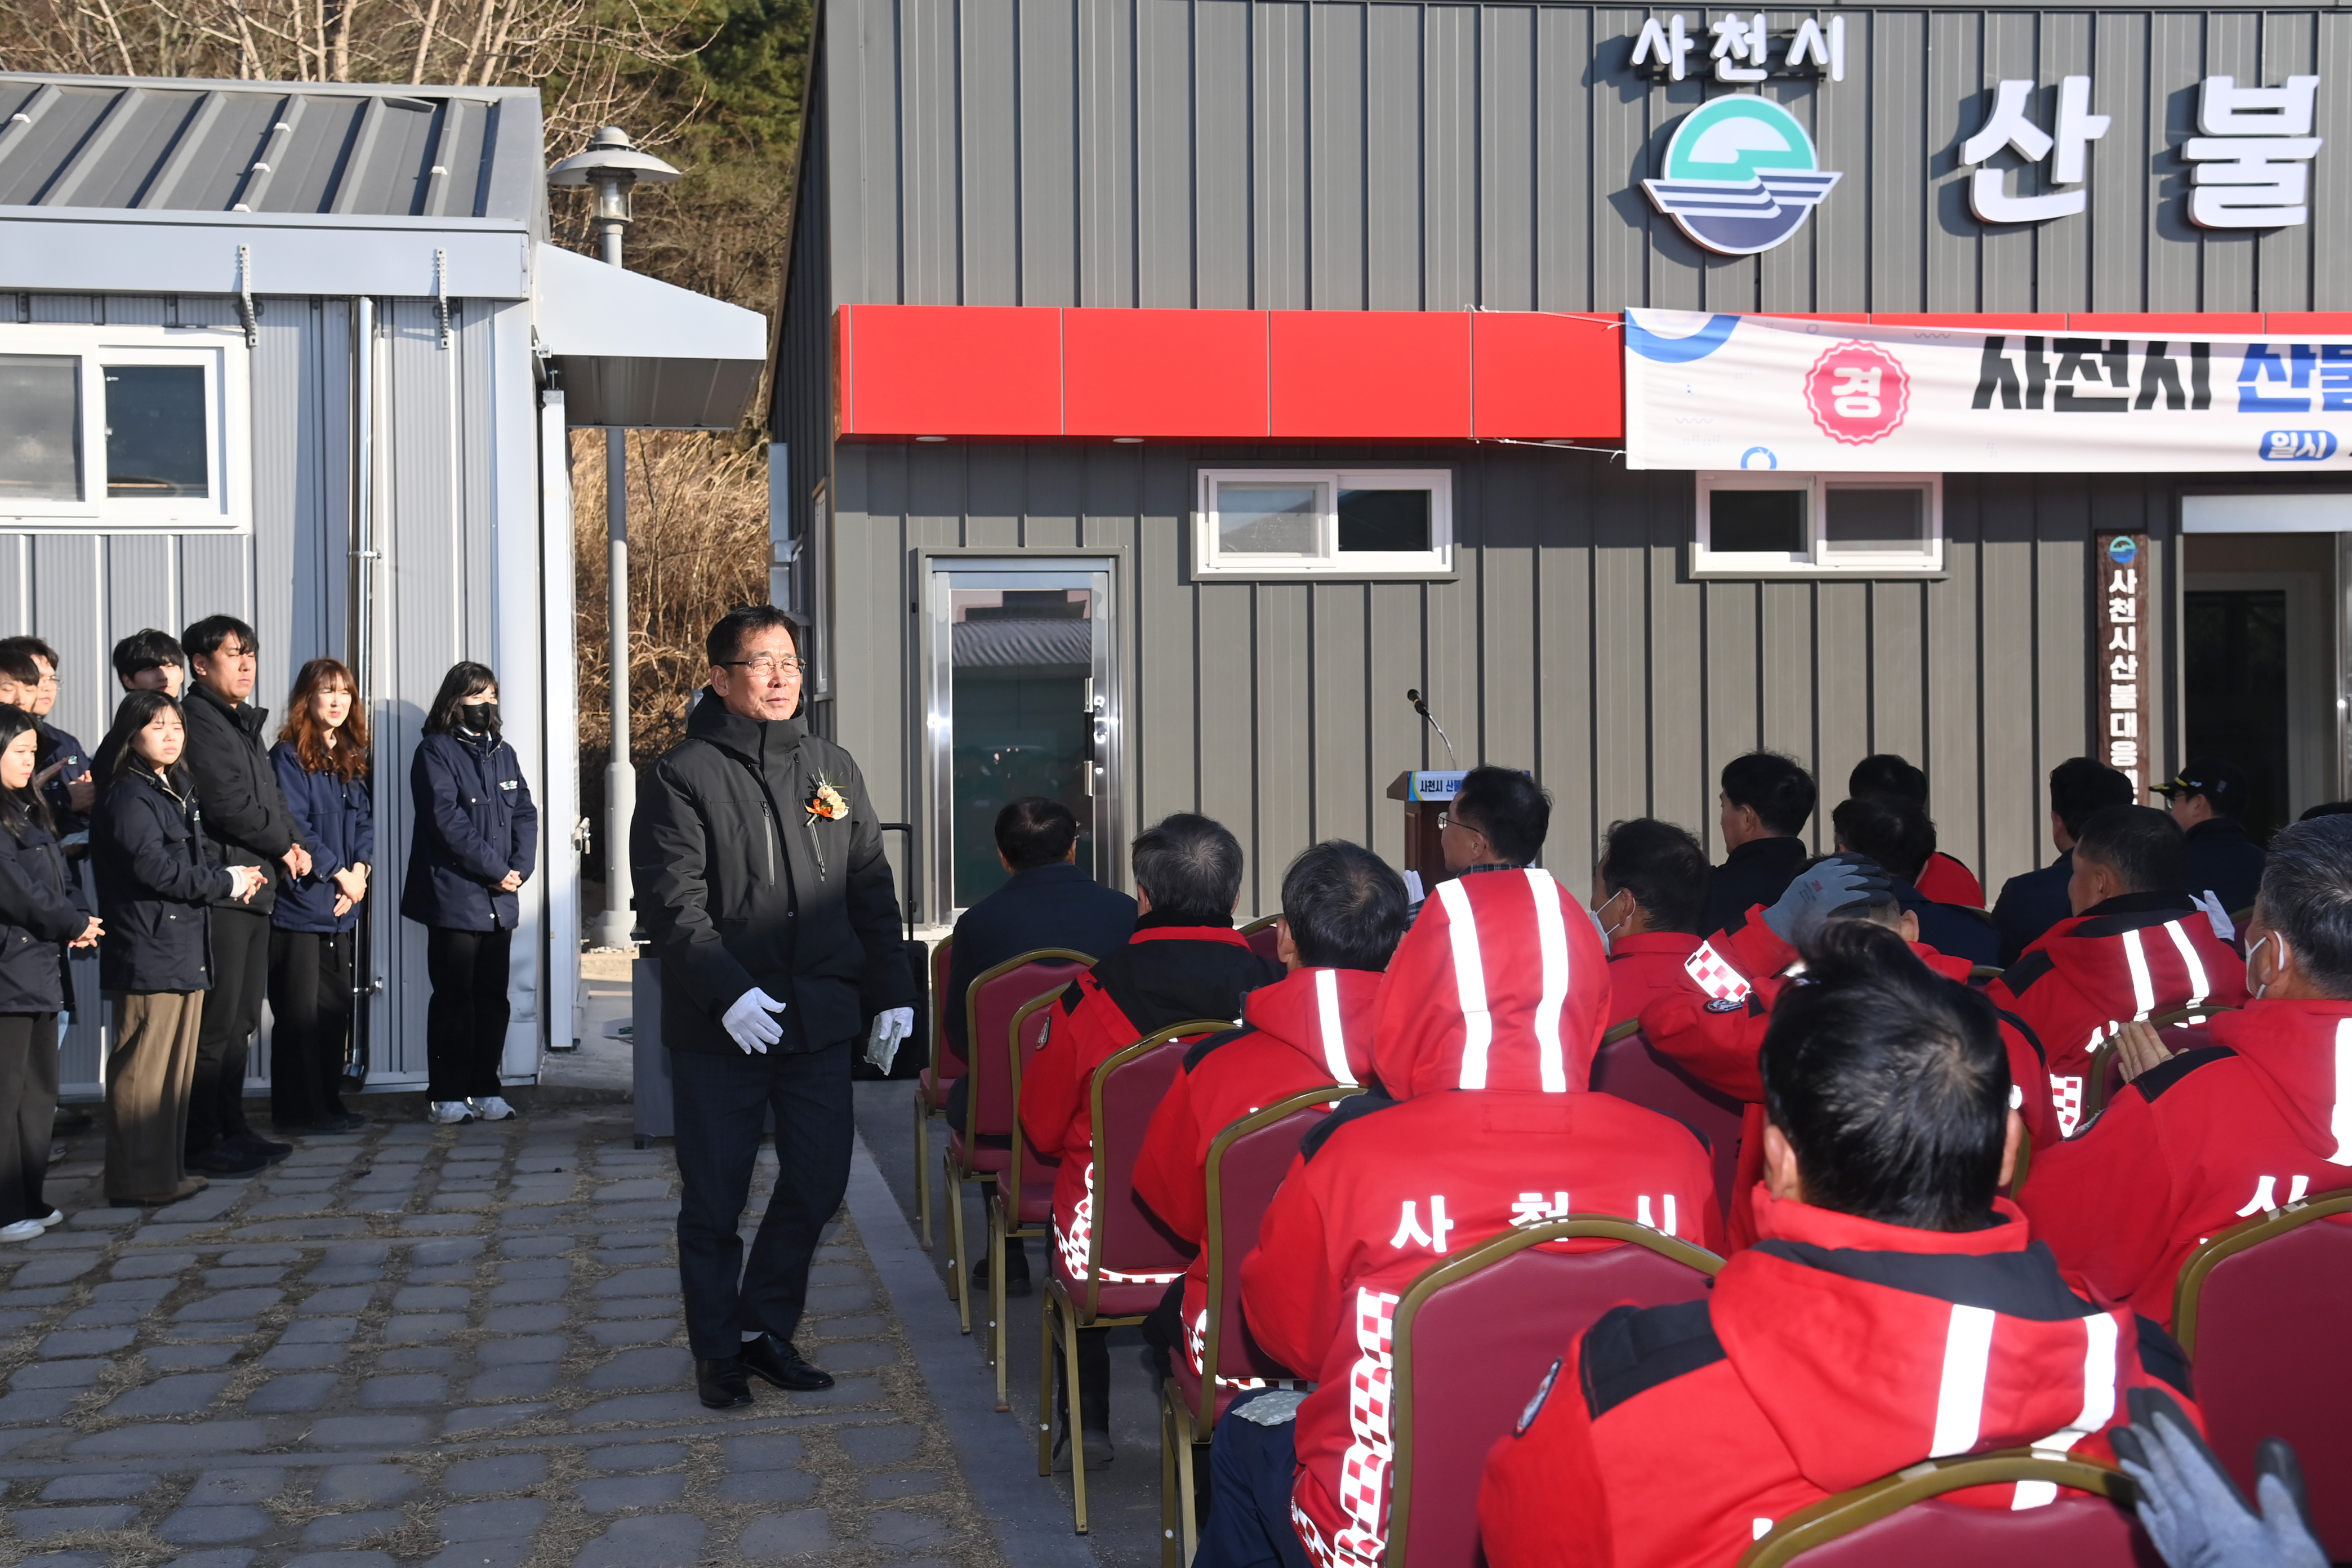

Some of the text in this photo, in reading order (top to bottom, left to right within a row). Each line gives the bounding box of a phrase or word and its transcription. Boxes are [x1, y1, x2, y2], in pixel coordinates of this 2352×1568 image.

[1632, 12, 1845, 82] 사천시
[1959, 75, 2323, 229] 산불
[1830, 363, 1883, 419] 경
[1971, 336, 2212, 413] 사천시
[2268, 431, 2328, 459] 일시
[1420, 779, 1443, 792] 사천시
